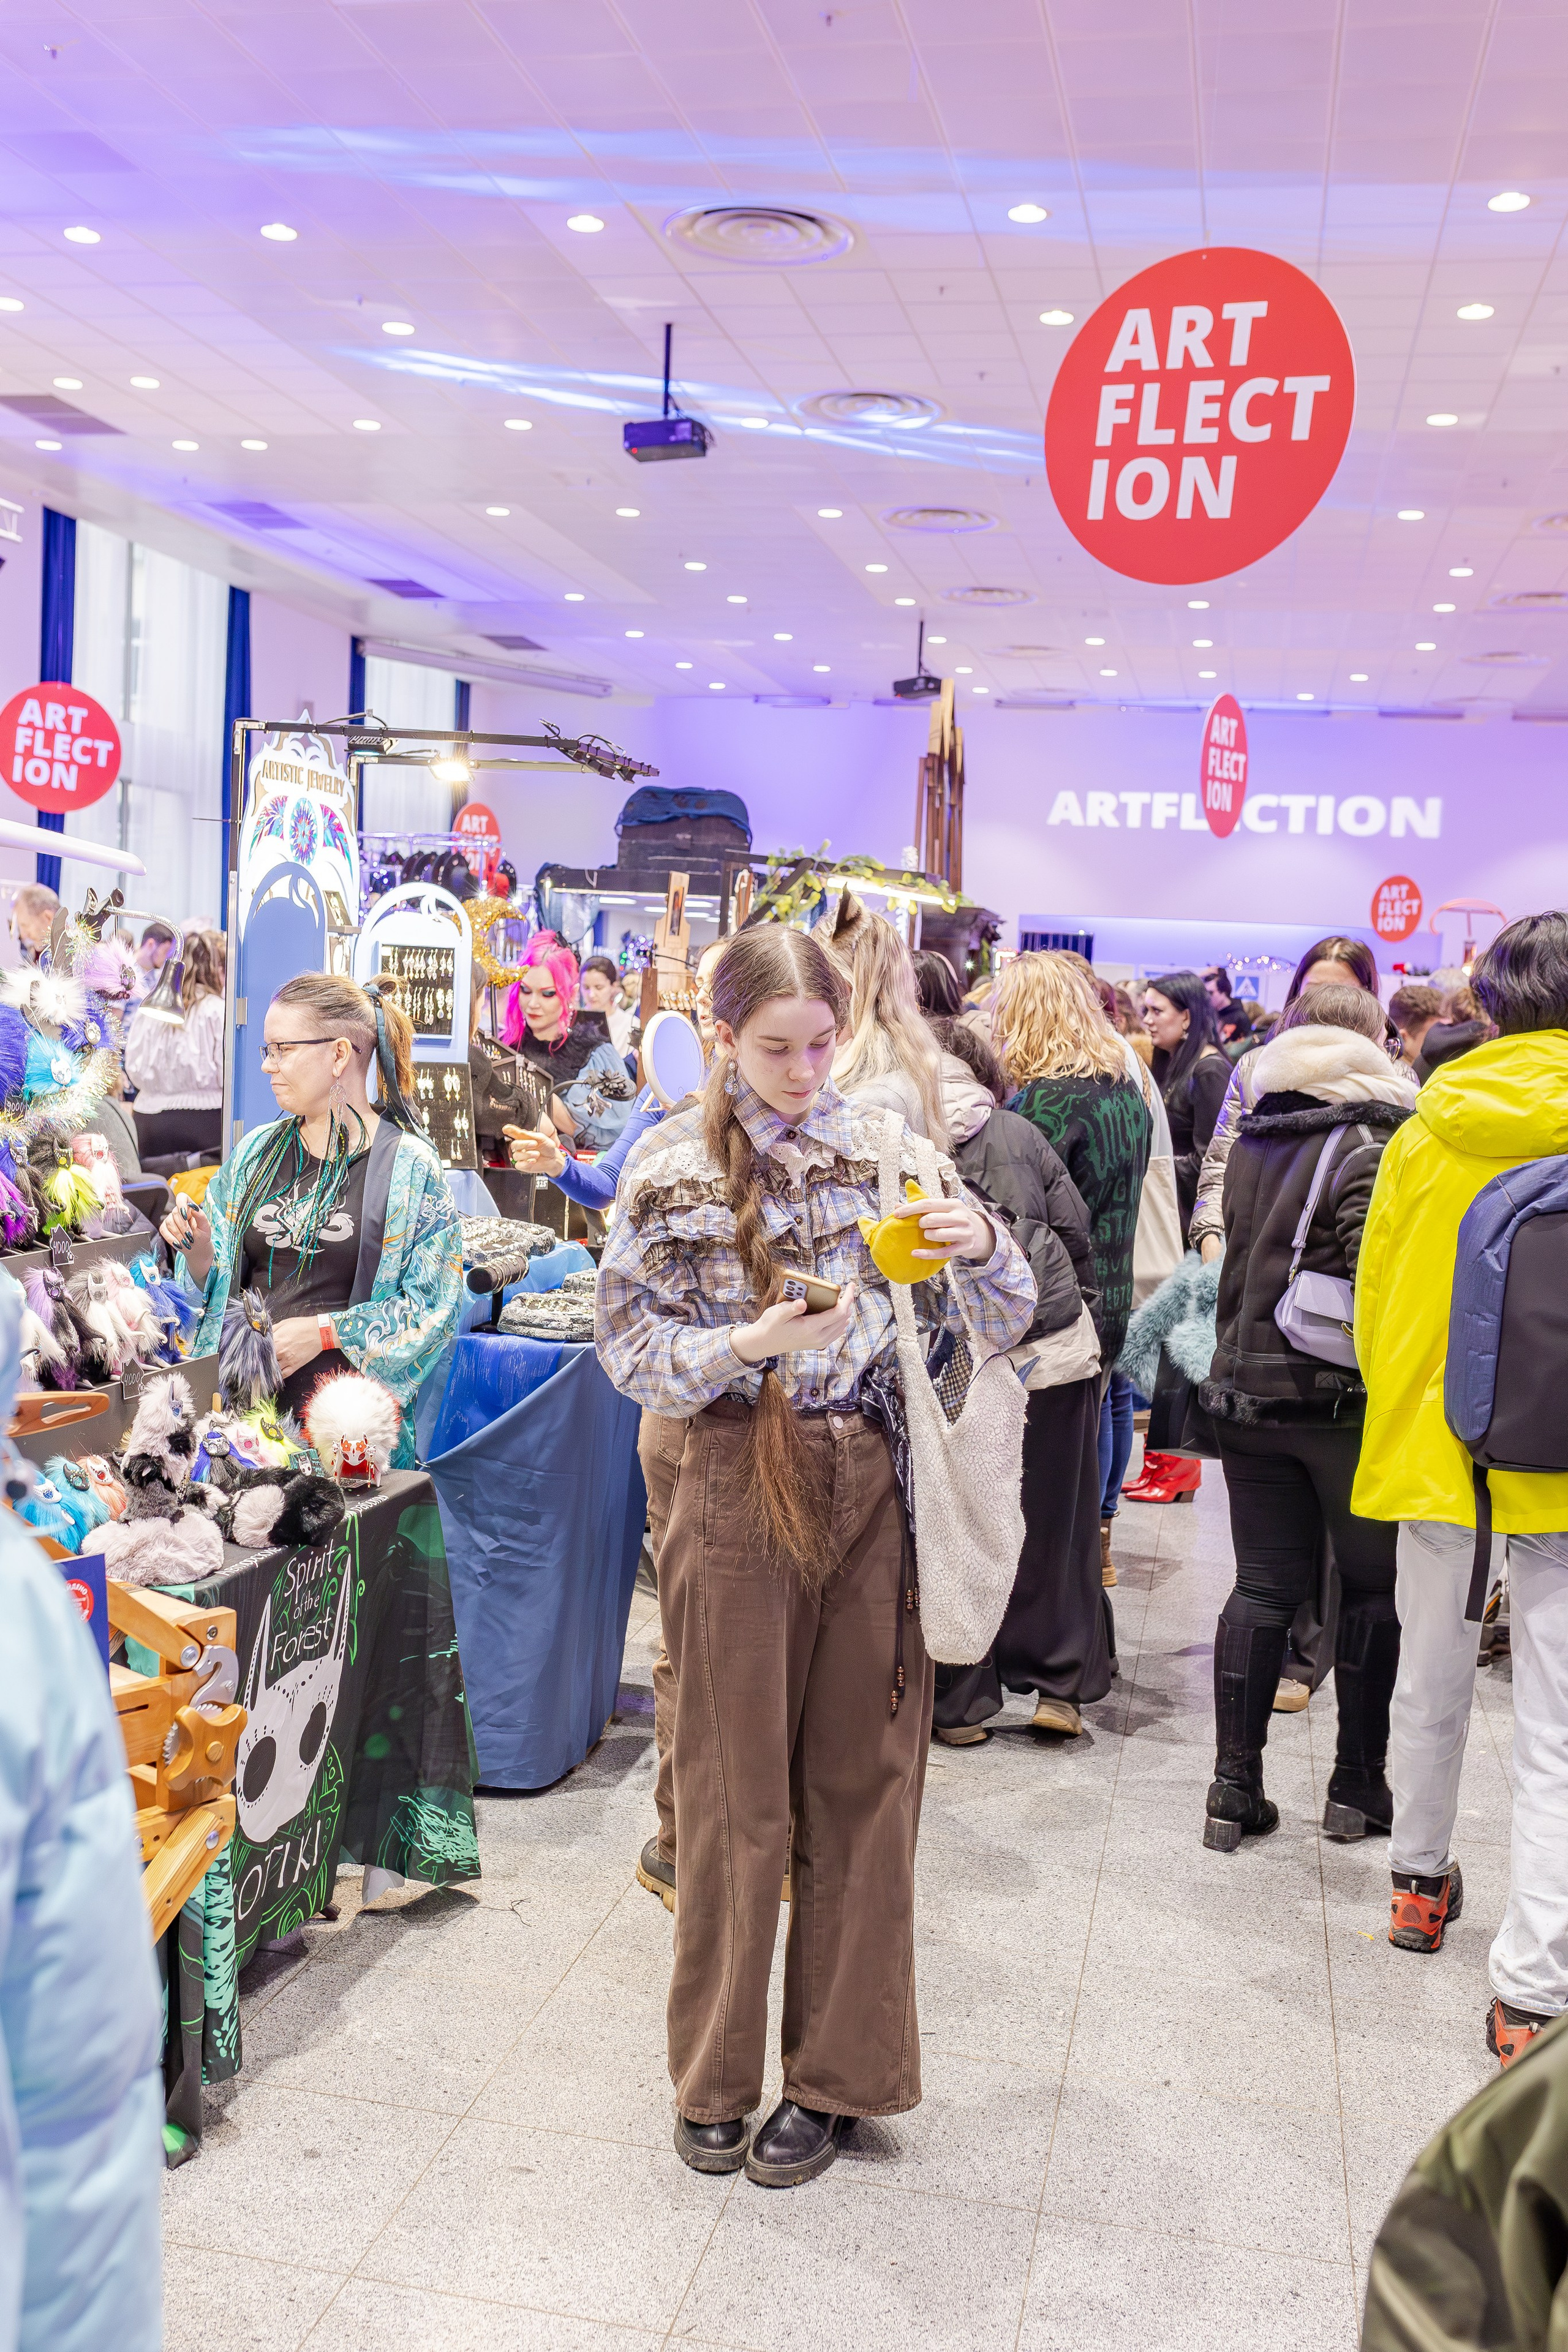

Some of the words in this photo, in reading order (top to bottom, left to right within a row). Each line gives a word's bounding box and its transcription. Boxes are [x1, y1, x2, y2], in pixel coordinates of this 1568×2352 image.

[1104, 301, 1268, 373] ART
[1095, 375, 1331, 447] FLECT
[1087, 455, 1237, 520] ION
[17, 698, 88, 734] ART
[1209, 713, 1238, 748] ART
[15, 725, 115, 768] FLECT
[1207, 745, 1247, 783] FLECT
[12, 755, 78, 792] ION
[262, 760, 304, 785] ARTISTIC
[307, 769, 345, 796] JEWELRY
[1205, 778, 1234, 813] ION
[461, 813, 489, 834] ART
[1046, 791, 1442, 839] ARTFLCTION
[1378, 899, 1421, 916] FLECT
[1379, 884, 1409, 900] ART
[1377, 916, 1406, 932] ION
[53, 1241, 69, 1255] 4000
[124, 1372, 141, 1385] 4000
[284, 1538, 335, 1605] Spirit
[293, 1593, 305, 1619] of
[304, 1590, 320, 1611] the
[270, 1606, 332, 1671] Forest
[232, 1819, 321, 1921] OTIKI
